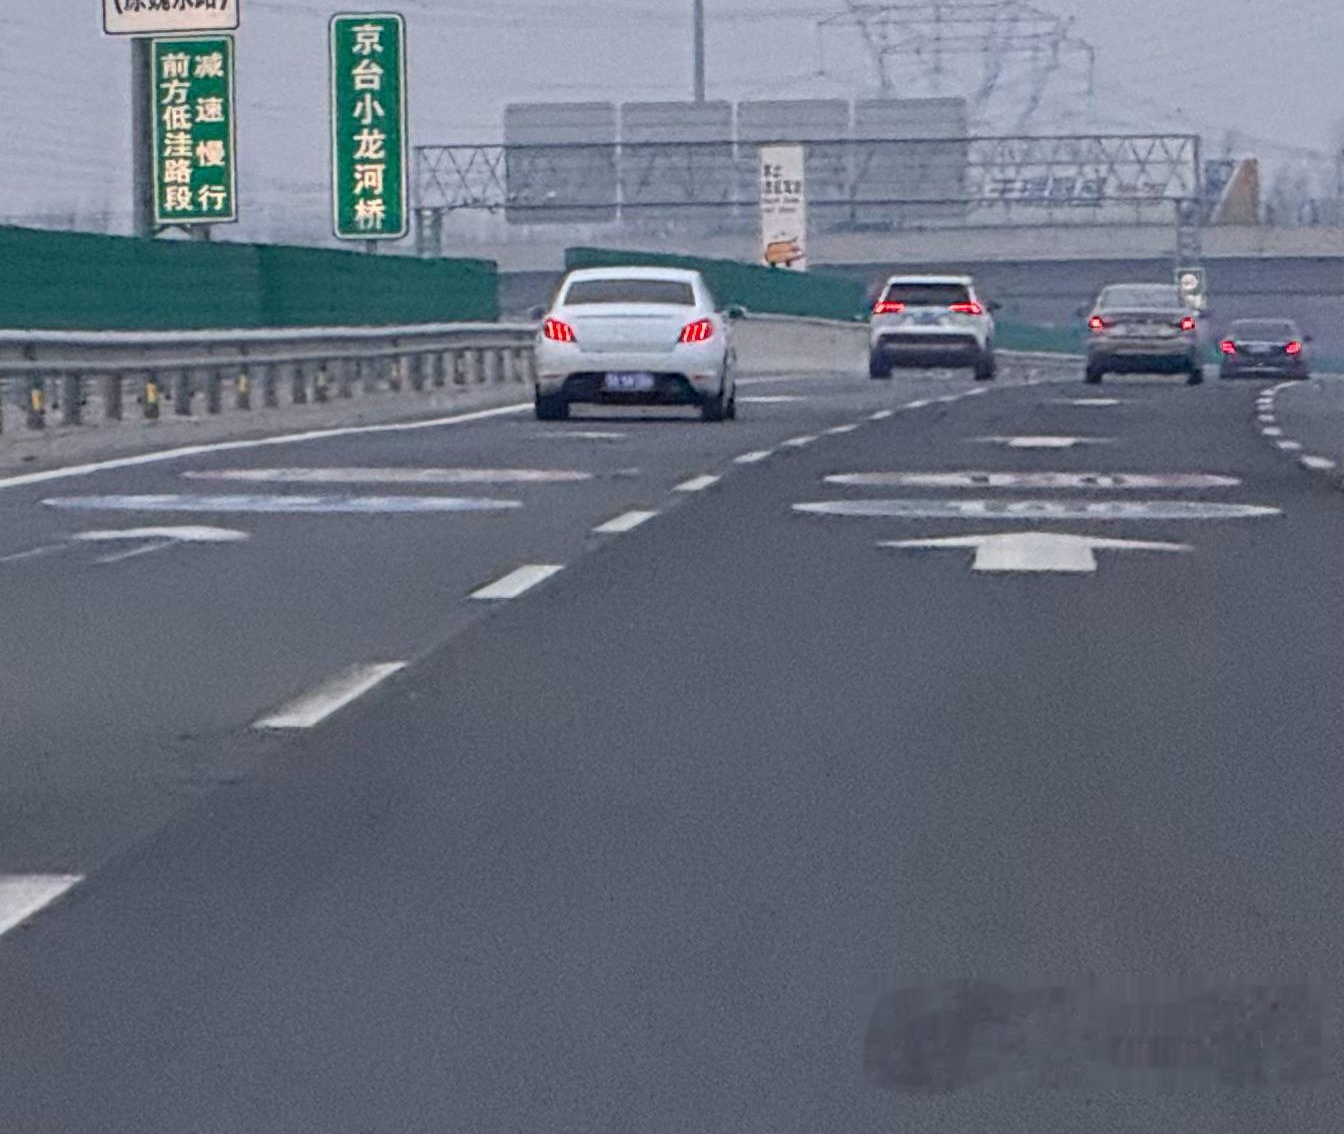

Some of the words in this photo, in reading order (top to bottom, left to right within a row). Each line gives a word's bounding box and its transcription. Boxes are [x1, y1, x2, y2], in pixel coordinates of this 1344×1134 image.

[160, 52, 193, 211] 前方低洼路段
[194, 53, 227, 211] 减速慢行
[352, 23, 386, 230] 京台小龙河桥
